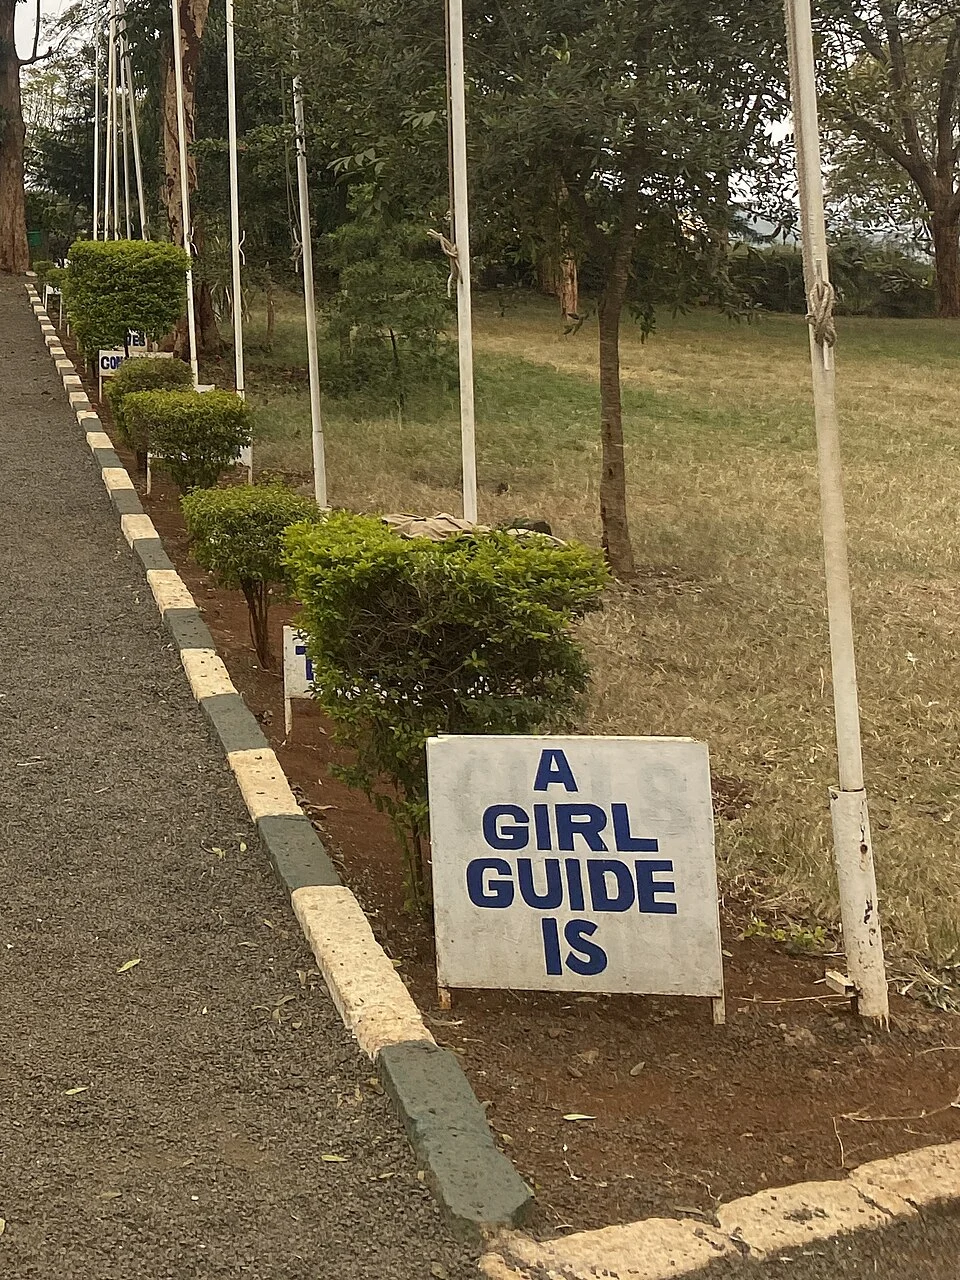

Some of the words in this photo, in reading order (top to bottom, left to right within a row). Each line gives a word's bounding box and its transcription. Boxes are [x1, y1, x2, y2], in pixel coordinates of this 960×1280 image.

[533, 749, 578, 792] A
[482, 802, 659, 853] GIRL
[466, 857, 678, 915] GUIDE
[541, 916, 608, 976] IS
